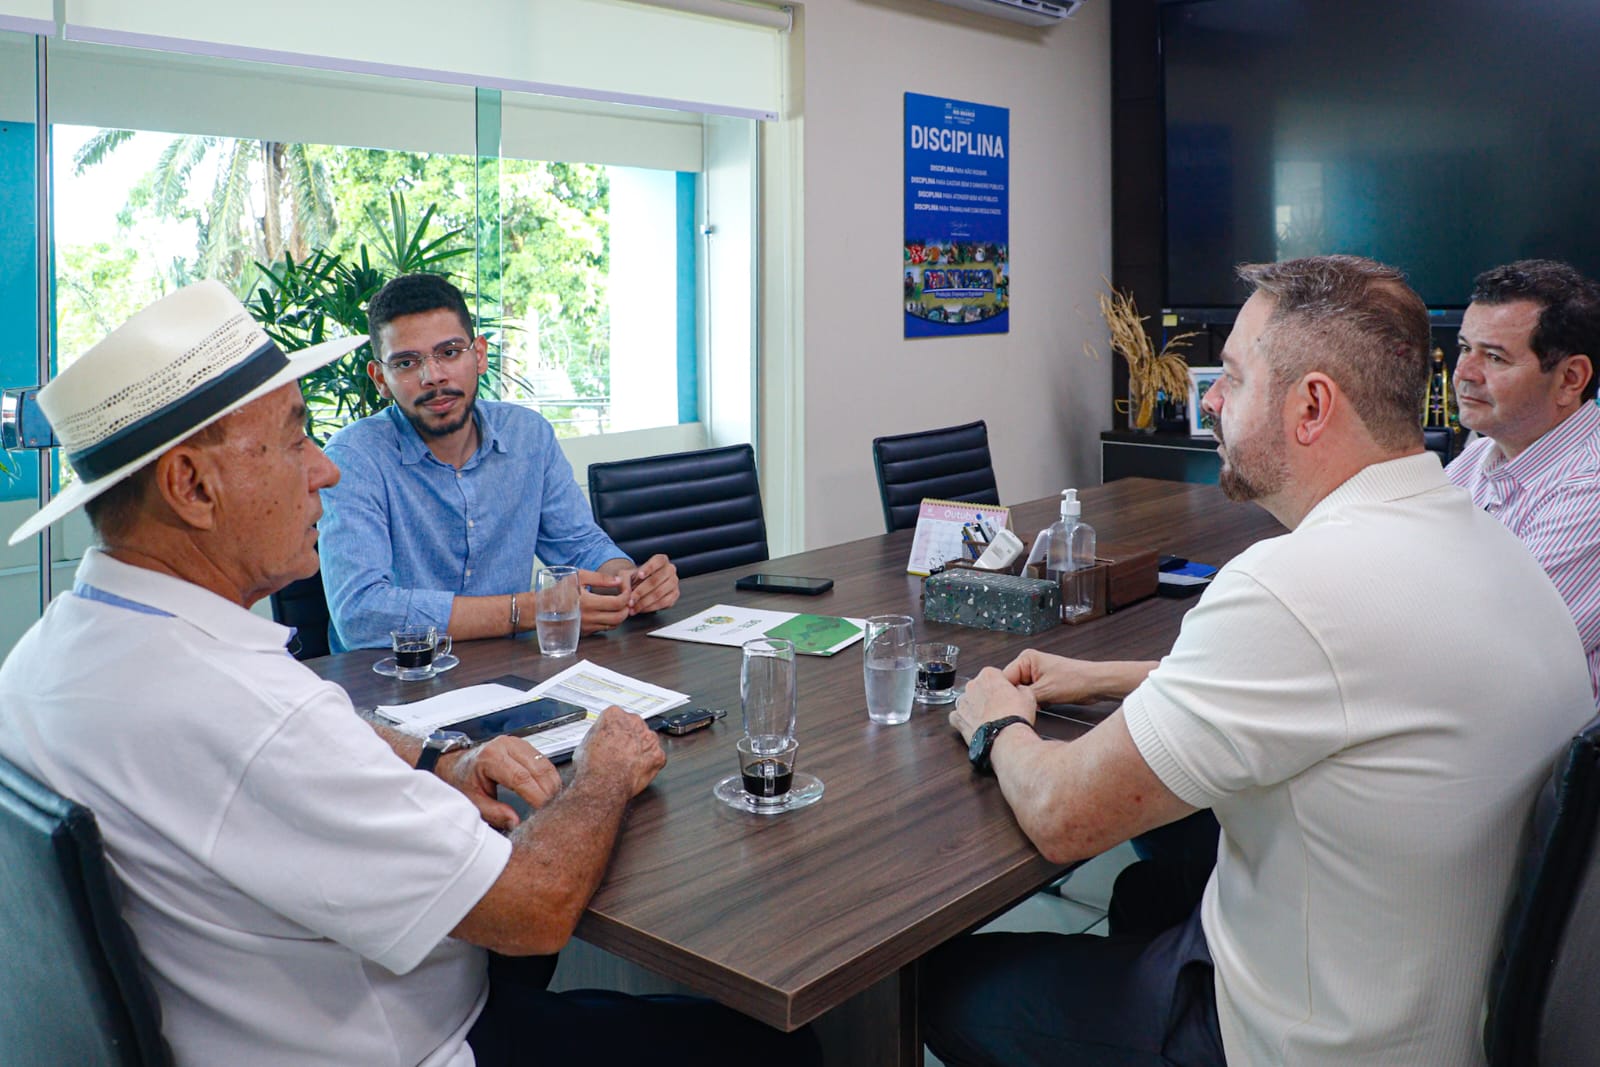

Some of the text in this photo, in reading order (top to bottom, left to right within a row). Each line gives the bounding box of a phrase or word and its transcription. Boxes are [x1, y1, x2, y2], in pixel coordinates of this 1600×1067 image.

[911, 124, 1004, 158] DISCIPLINA
[930, 164, 954, 173] DISCIPLINA
[911, 176, 936, 184] DISCIPLINA
[918, 190, 942, 199] DISCIPLINA
[914, 203, 939, 212] DISCIPLINA
